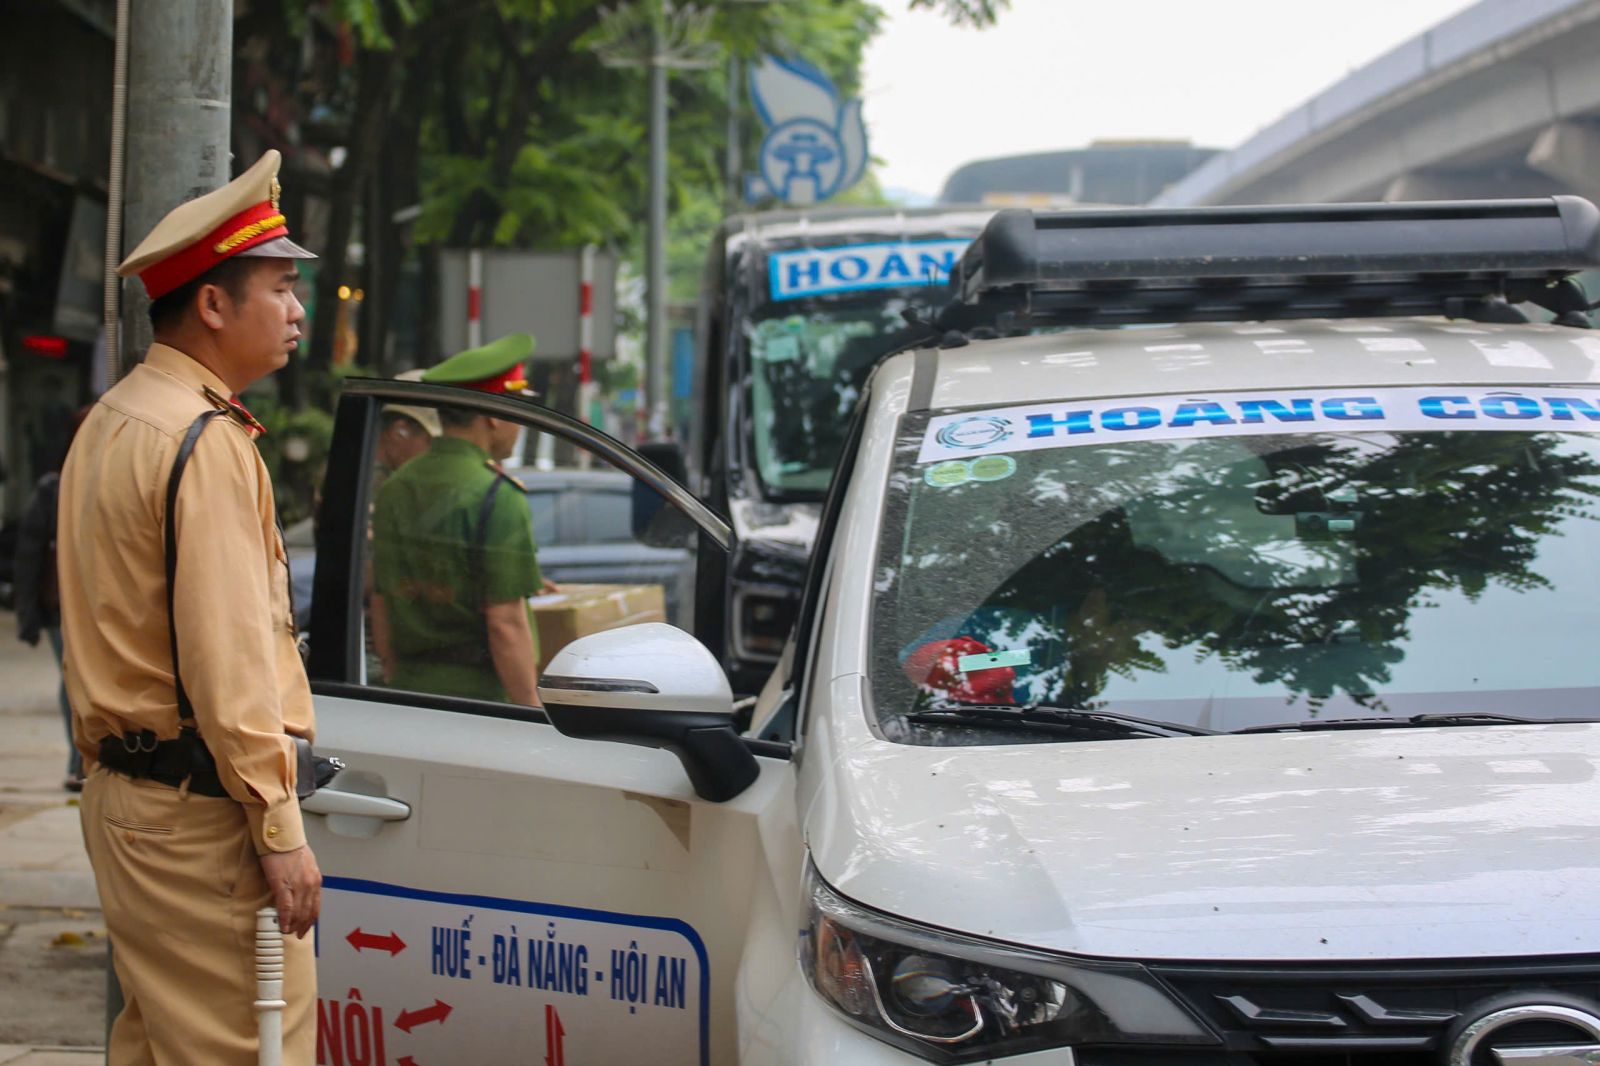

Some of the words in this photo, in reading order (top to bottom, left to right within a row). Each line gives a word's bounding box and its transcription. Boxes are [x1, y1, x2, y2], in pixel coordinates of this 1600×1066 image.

[1026, 397, 1385, 438] HOÀNG
[432, 914, 474, 979] HUẾ
[493, 925, 521, 986] ĐÀ
[611, 940, 647, 1014] HỘI
[654, 955, 686, 1009] AN
